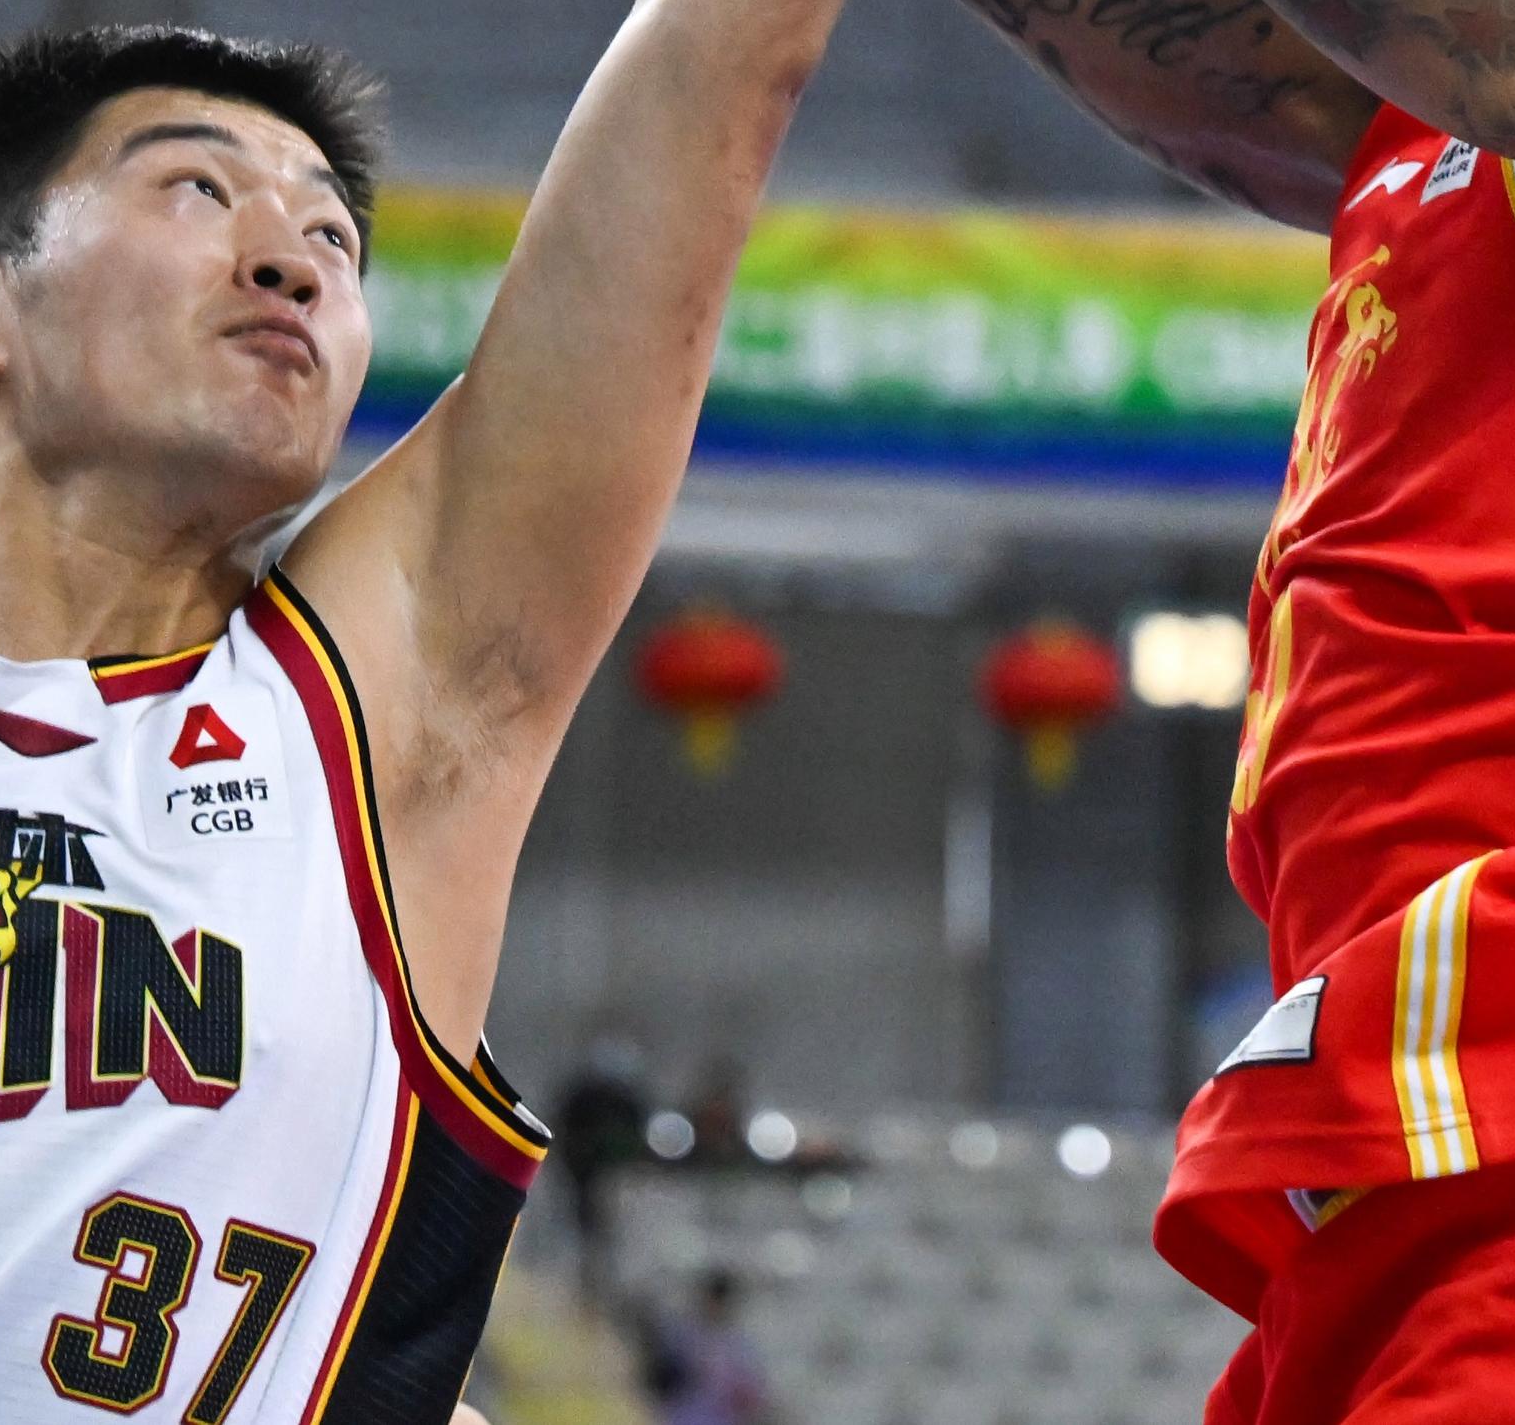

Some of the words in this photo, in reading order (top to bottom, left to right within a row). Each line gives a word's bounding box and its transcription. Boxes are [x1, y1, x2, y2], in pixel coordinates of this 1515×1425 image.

[165, 777, 269, 815] 广发银行
[190, 808, 254, 835] CGB
[41, 1189, 317, 1425] 37
